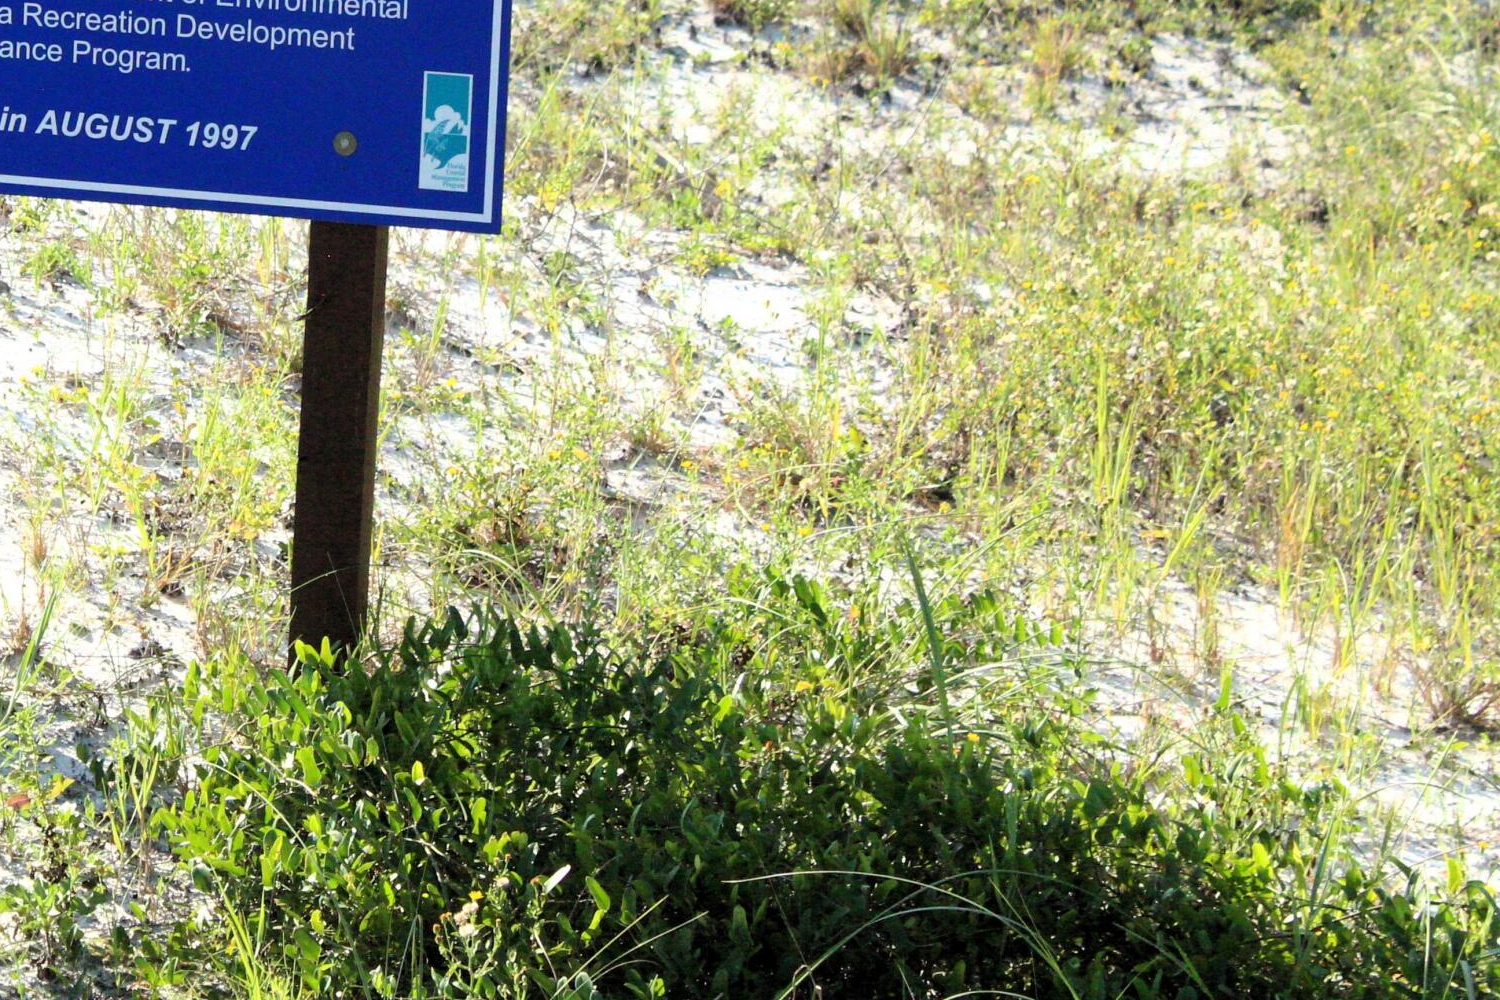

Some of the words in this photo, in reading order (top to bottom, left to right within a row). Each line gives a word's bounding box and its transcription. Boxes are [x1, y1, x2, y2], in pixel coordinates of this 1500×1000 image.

[22, 1, 166, 36] Recreation
[176, 13, 356, 51] Development
[72, 39, 191, 74] Program.
[34, 109, 178, 145] AUGUST
[186, 121, 259, 151] 1997
